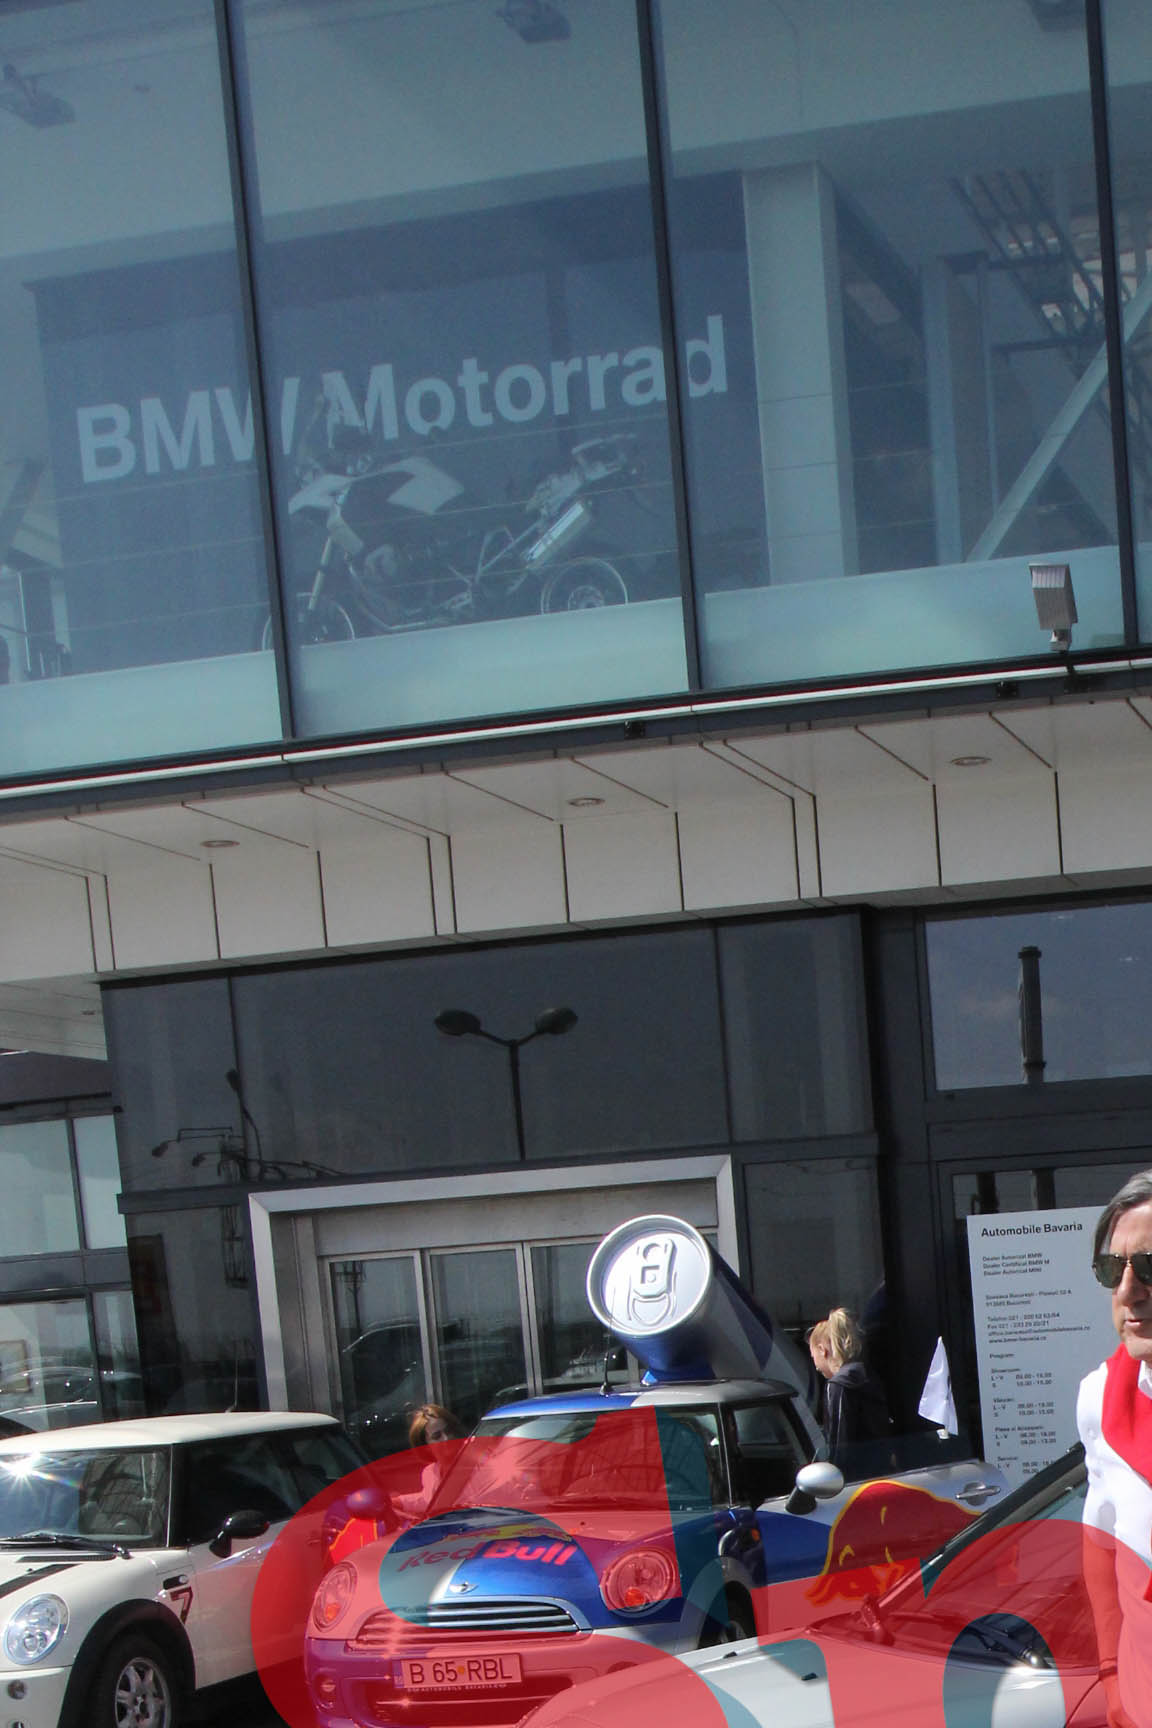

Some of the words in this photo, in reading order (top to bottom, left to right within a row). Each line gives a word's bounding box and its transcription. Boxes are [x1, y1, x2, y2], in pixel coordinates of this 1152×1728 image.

[76, 377, 299, 484] BMW
[324, 314, 729, 442] Motorrad
[982, 1225, 1042, 1238] Automobile
[1044, 1222, 1082, 1233] Bavaria
[397, 1541, 484, 1572] Red
[482, 1540, 578, 1566] Bull
[410, 1664, 425, 1684] B
[433, 1661, 458, 1682] 65
[467, 1658, 512, 1681] RBL
